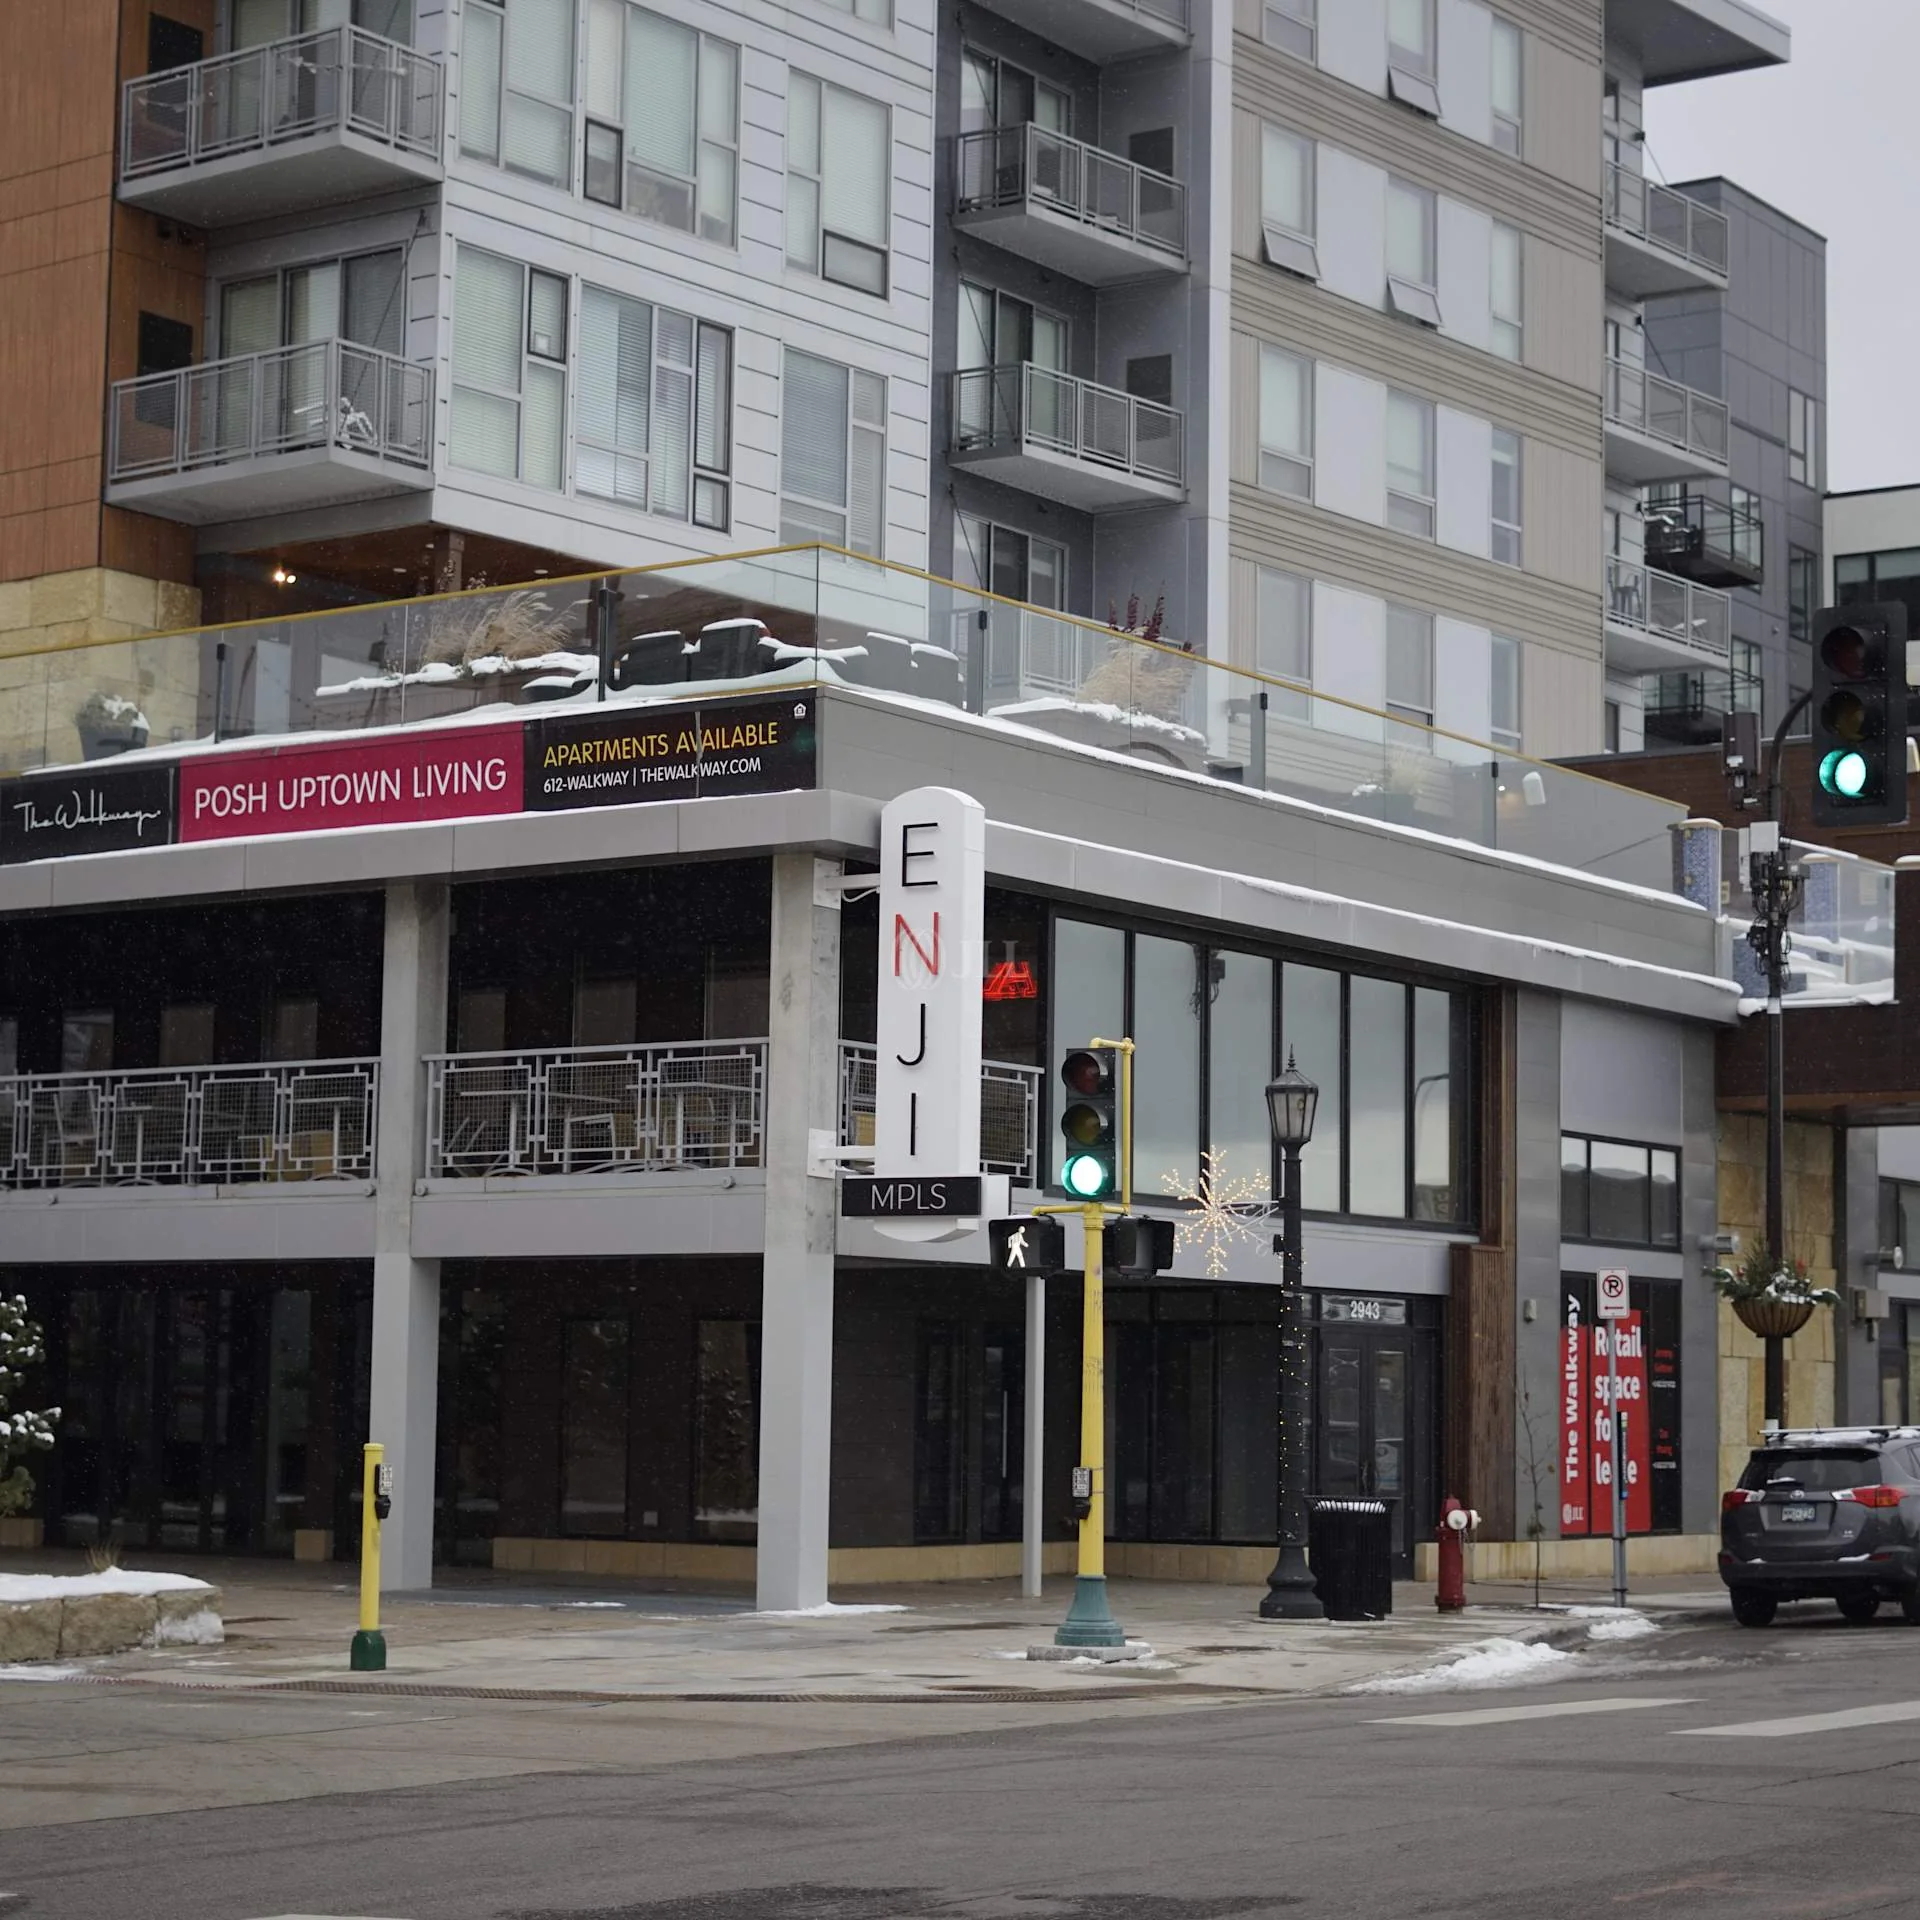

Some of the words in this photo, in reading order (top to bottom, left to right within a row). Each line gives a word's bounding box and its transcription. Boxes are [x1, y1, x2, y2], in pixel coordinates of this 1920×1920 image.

[544, 733, 668, 768] APARTMENTS
[676, 721, 778, 754] AVAILABLE
[195, 781, 267, 820] POSH
[279, 768, 400, 810] UPTOWN
[413, 758, 507, 798] LIVING
[543, 770, 629, 793] 612-WALKWAY
[640, 756, 761, 784] THEWALKWAY.COM
[13, 802, 54, 832] The
[55, 789, 161, 836] Walkway
[894, 822, 939, 1156] ENJI
[871, 1183, 947, 1210] MPLS
[1350, 1300, 1380, 1319] 2943
[1565, 1293, 1580, 1424] Walkway
[1565, 1429, 1579, 1484] The
[1595, 1452, 1638, 1485] lee
